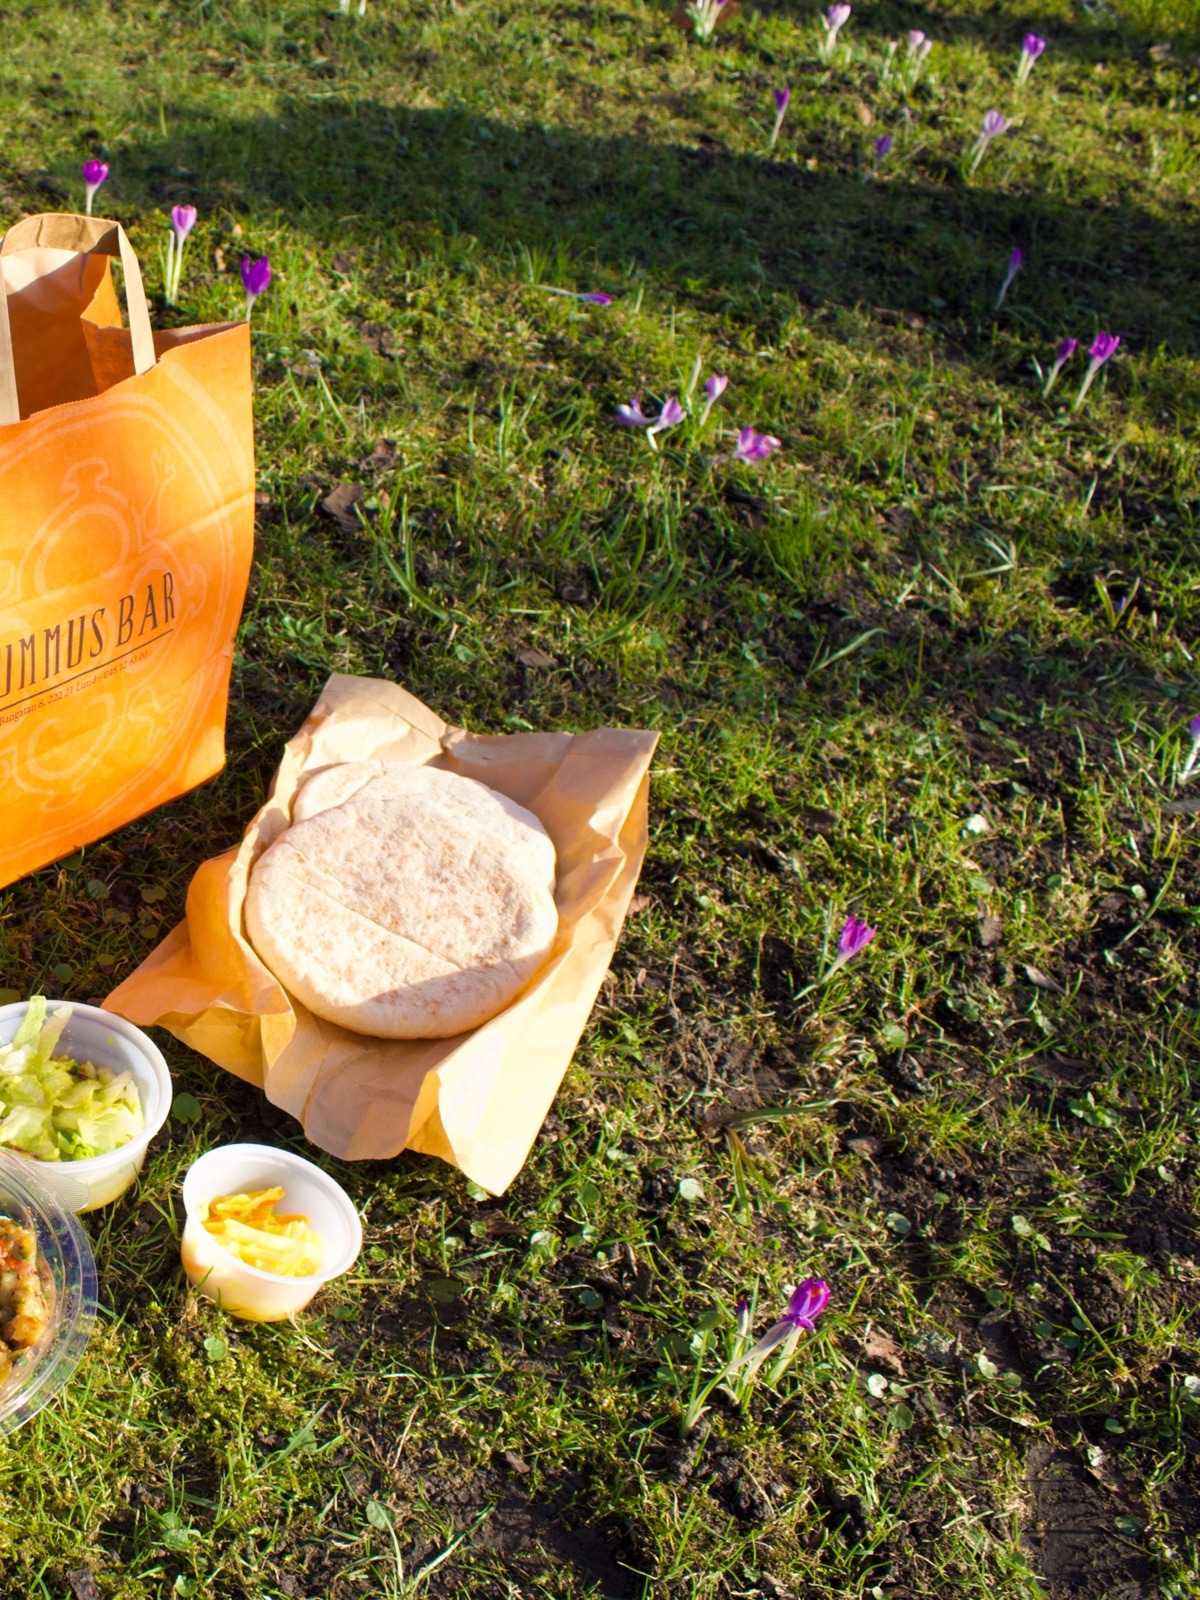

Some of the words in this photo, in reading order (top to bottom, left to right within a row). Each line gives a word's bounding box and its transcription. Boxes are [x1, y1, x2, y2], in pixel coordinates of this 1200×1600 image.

[115, 572, 175, 648] BAR
[48, 692, 63, 704] 222
[64, 686, 74, 698] 21
[76, 675, 97, 692] Lund
[119, 661, 128, 672] 12
